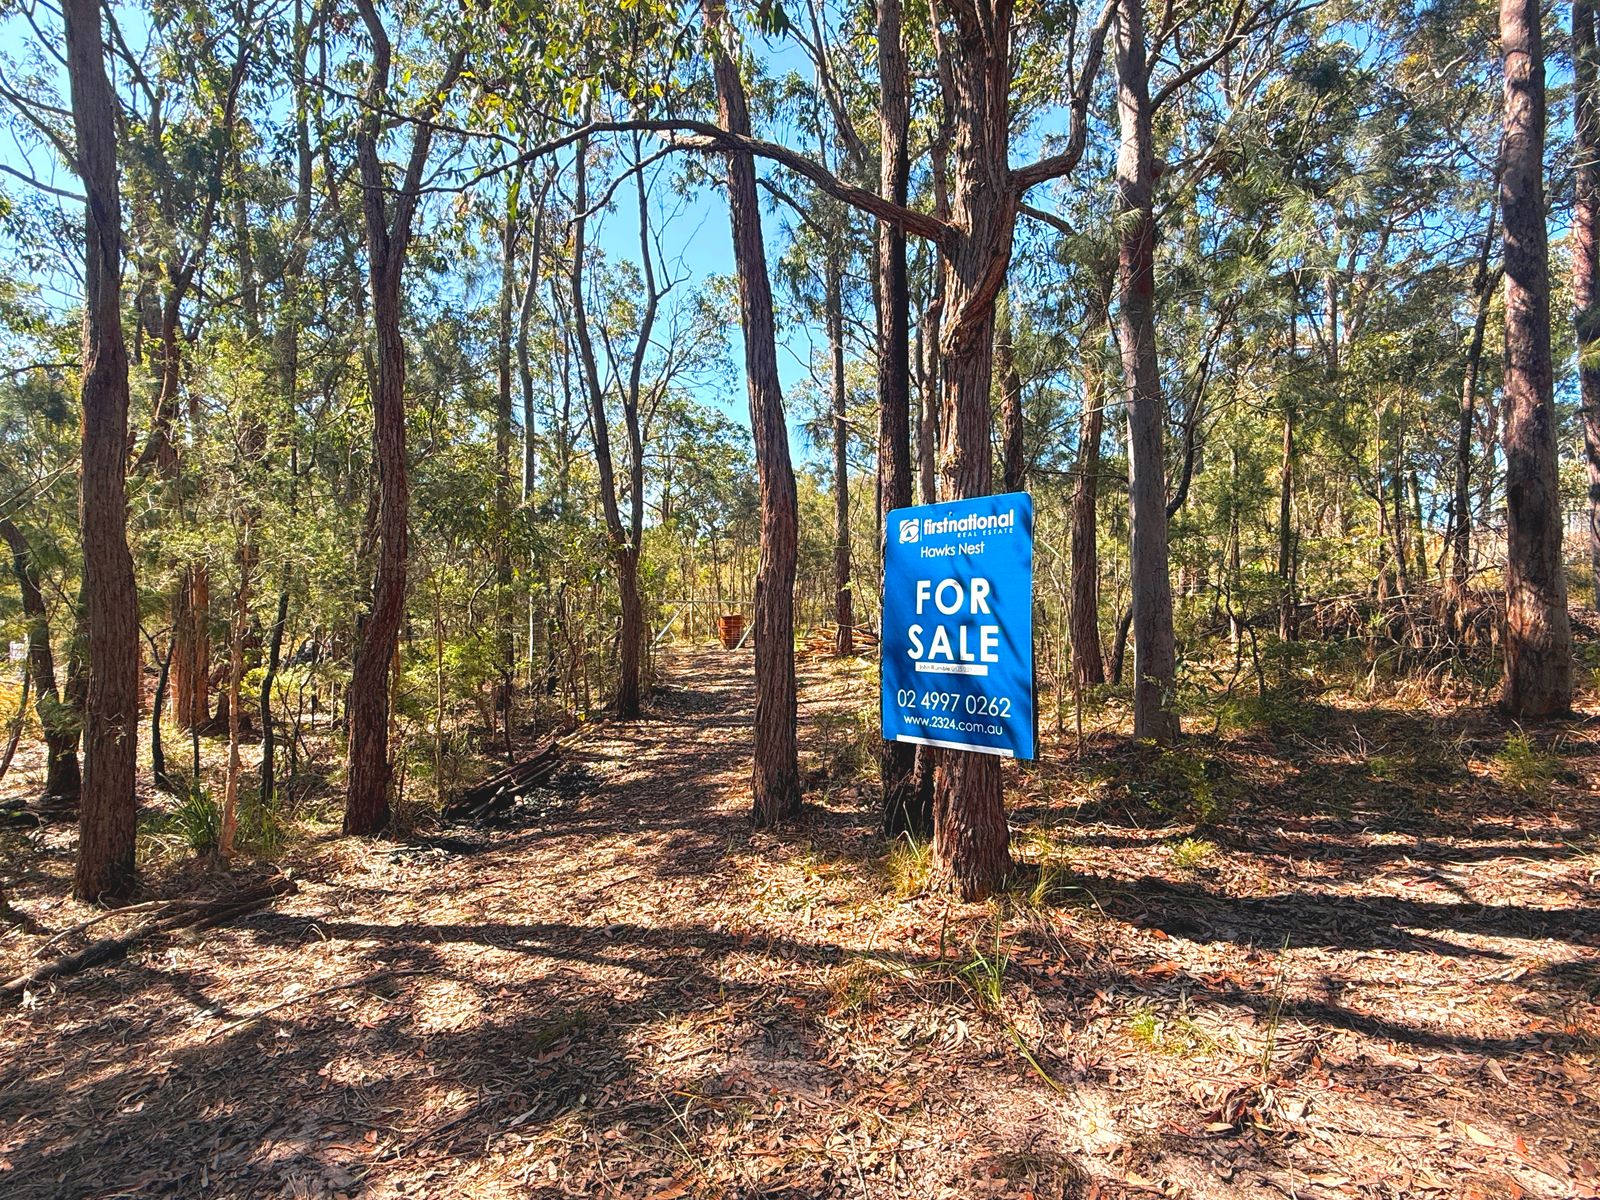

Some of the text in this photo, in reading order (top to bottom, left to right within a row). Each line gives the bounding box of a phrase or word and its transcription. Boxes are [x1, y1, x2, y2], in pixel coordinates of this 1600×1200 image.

[924, 509, 1014, 535] firstnational
[982, 528, 1013, 536] ESTATE
[921, 541, 985, 558] Hawks Nest
[916, 577, 991, 615] FOR
[907, 624, 999, 662] SALE
[897, 689, 1011, 718] 02 4997 0262
[903, 715, 1003, 735] www.2324.com.au
